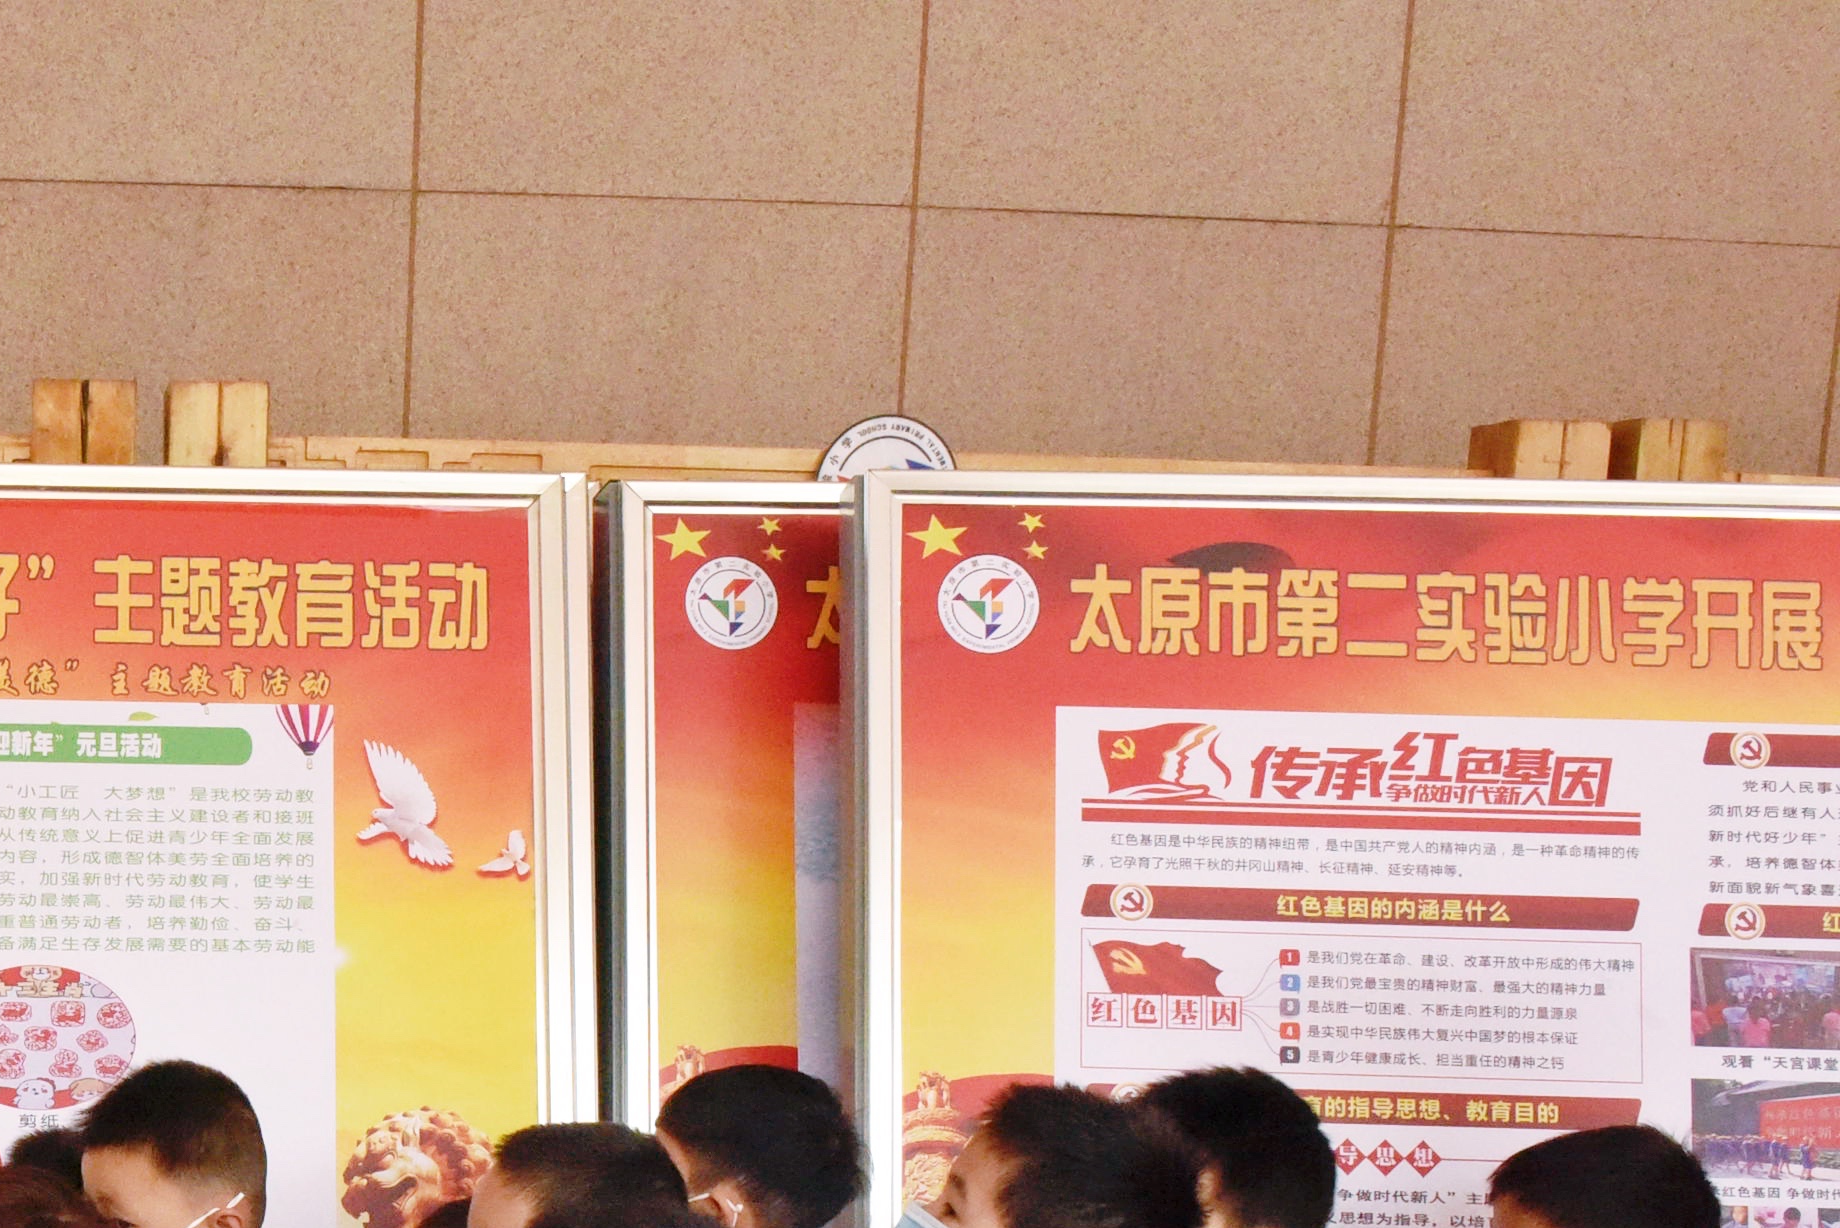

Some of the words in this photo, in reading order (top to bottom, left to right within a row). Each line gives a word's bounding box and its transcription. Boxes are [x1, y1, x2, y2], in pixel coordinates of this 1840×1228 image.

[92, 554, 489, 652] 主题教育活动
[1068, 563, 1824, 671] 太原市第二实验小学开展
[109, 661, 331, 700] 主题教育活动
[75, 731, 161, 759] 元旦活动
[1250, 731, 1613, 807] 传承红色基因
[1386, 783, 1546, 806] 争做时代新人
[1708, 803, 1840, 820] 须抓好后继有人
[1708, 855, 1840, 871] 承，培养德智体
[1708, 880, 1840, 897] 新面貌新气象喜
[1276, 894, 1511, 922] 红色基因的内涵是什么
[1089, 996, 1238, 1028] 红色基因
